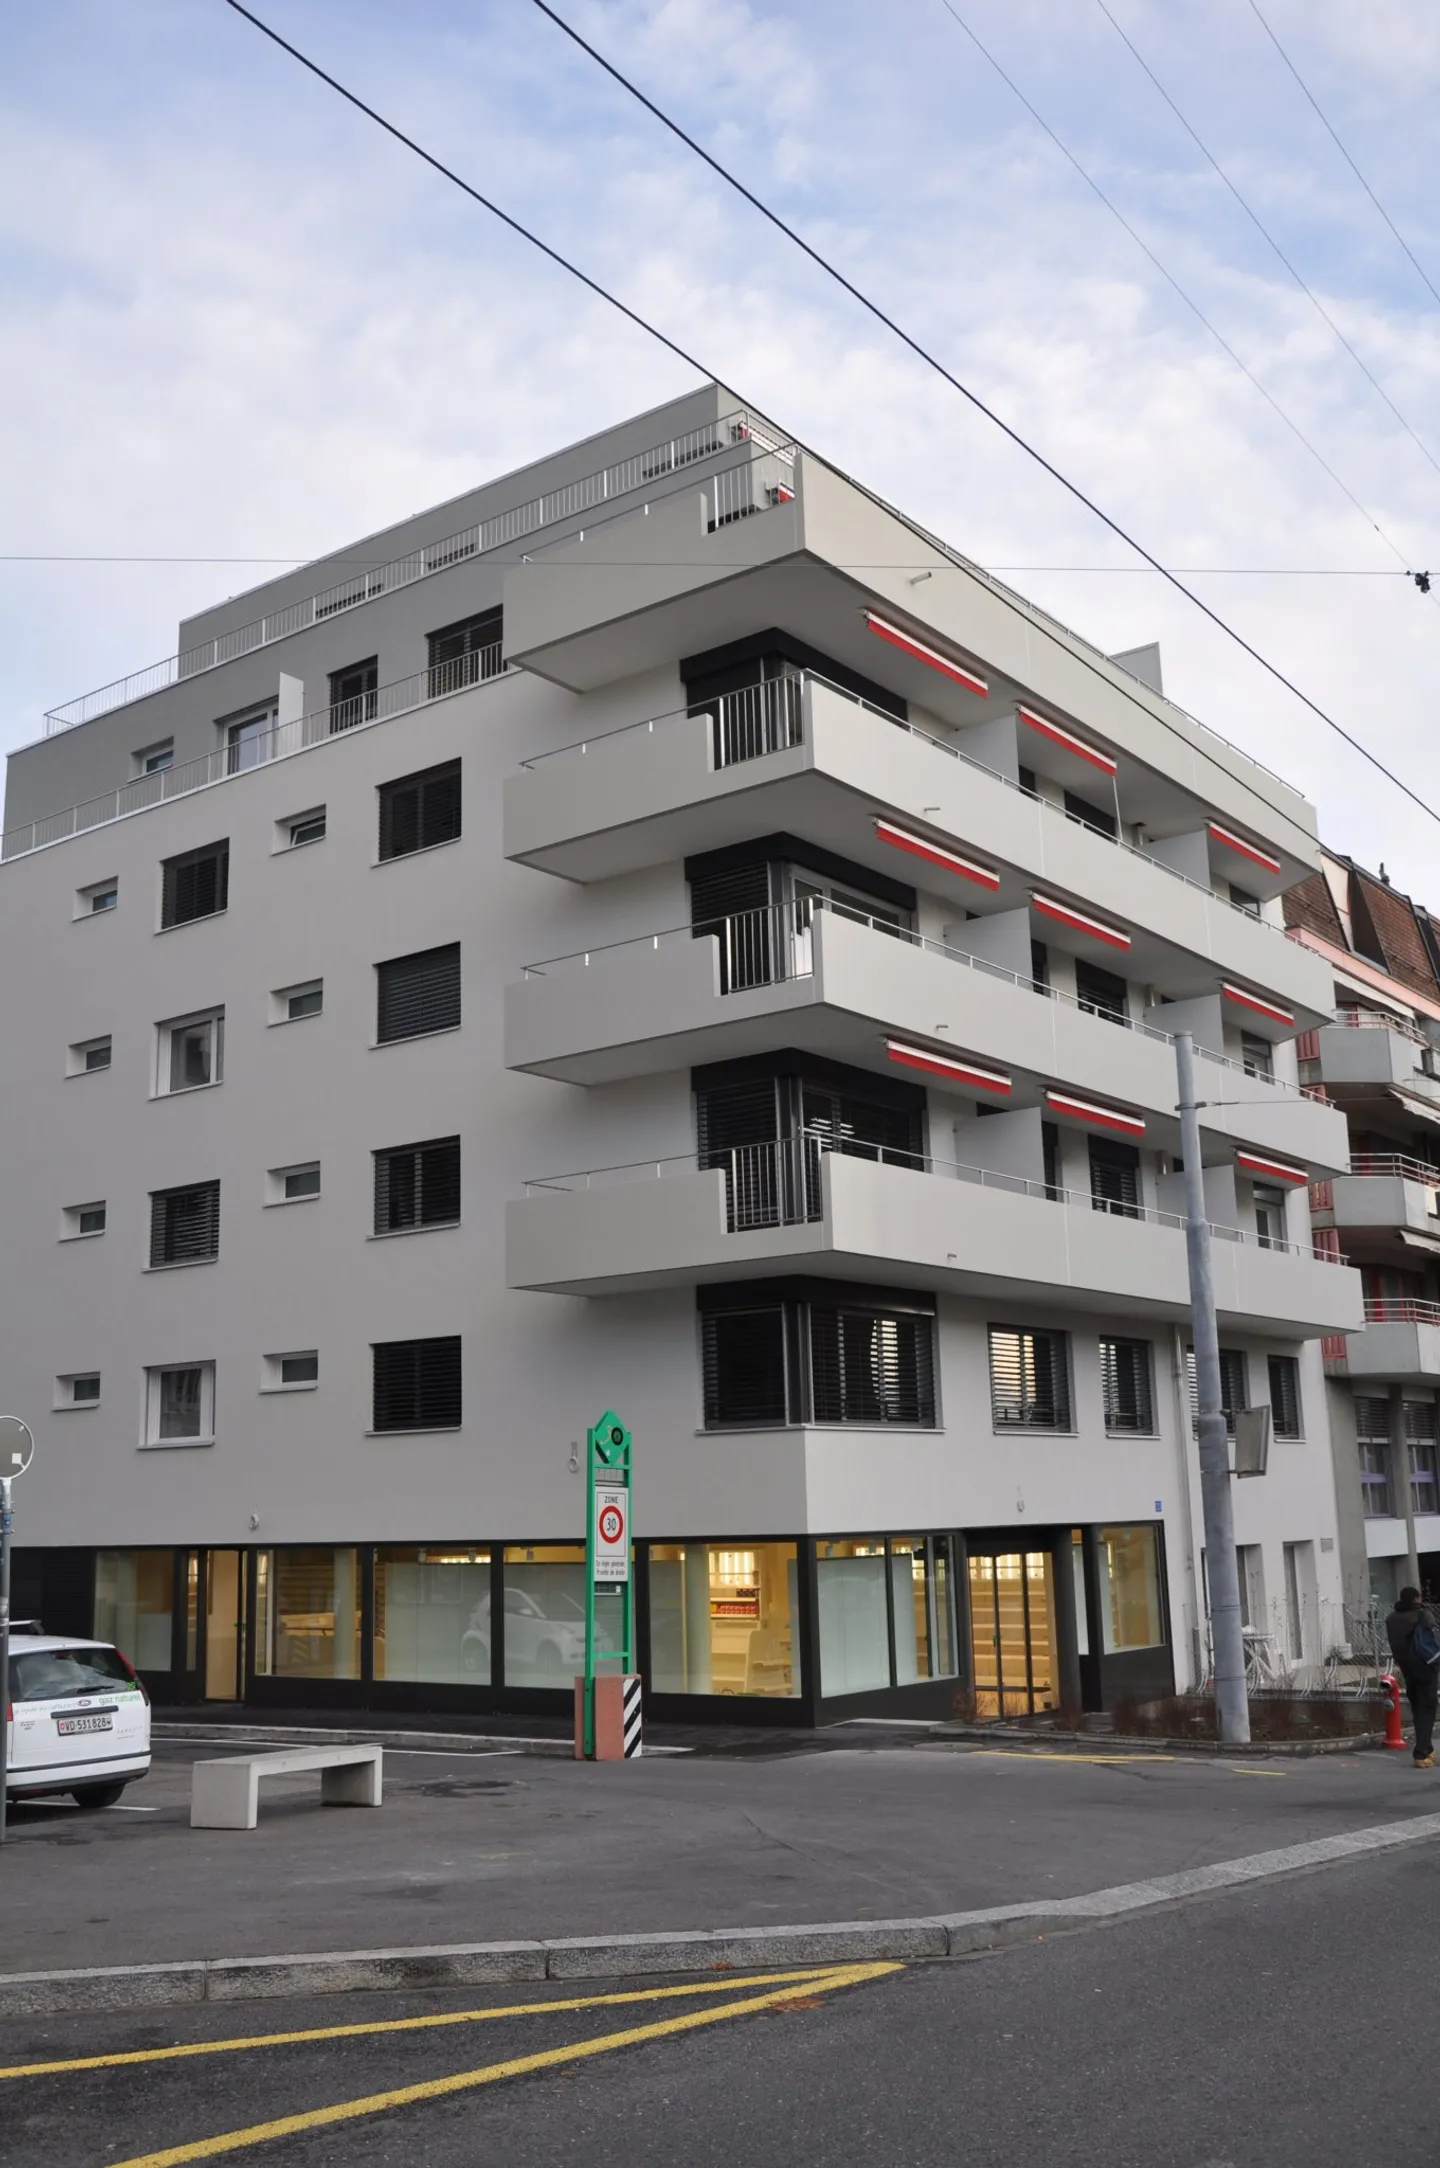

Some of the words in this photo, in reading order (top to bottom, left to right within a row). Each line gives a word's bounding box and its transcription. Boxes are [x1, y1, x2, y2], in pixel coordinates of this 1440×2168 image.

[604, 1495, 618, 1504] ZONE
[606, 1517, 617, 1532] 30
[98, 1696, 112, 1705] gaz
[115, 1692, 141, 1703] naturel
